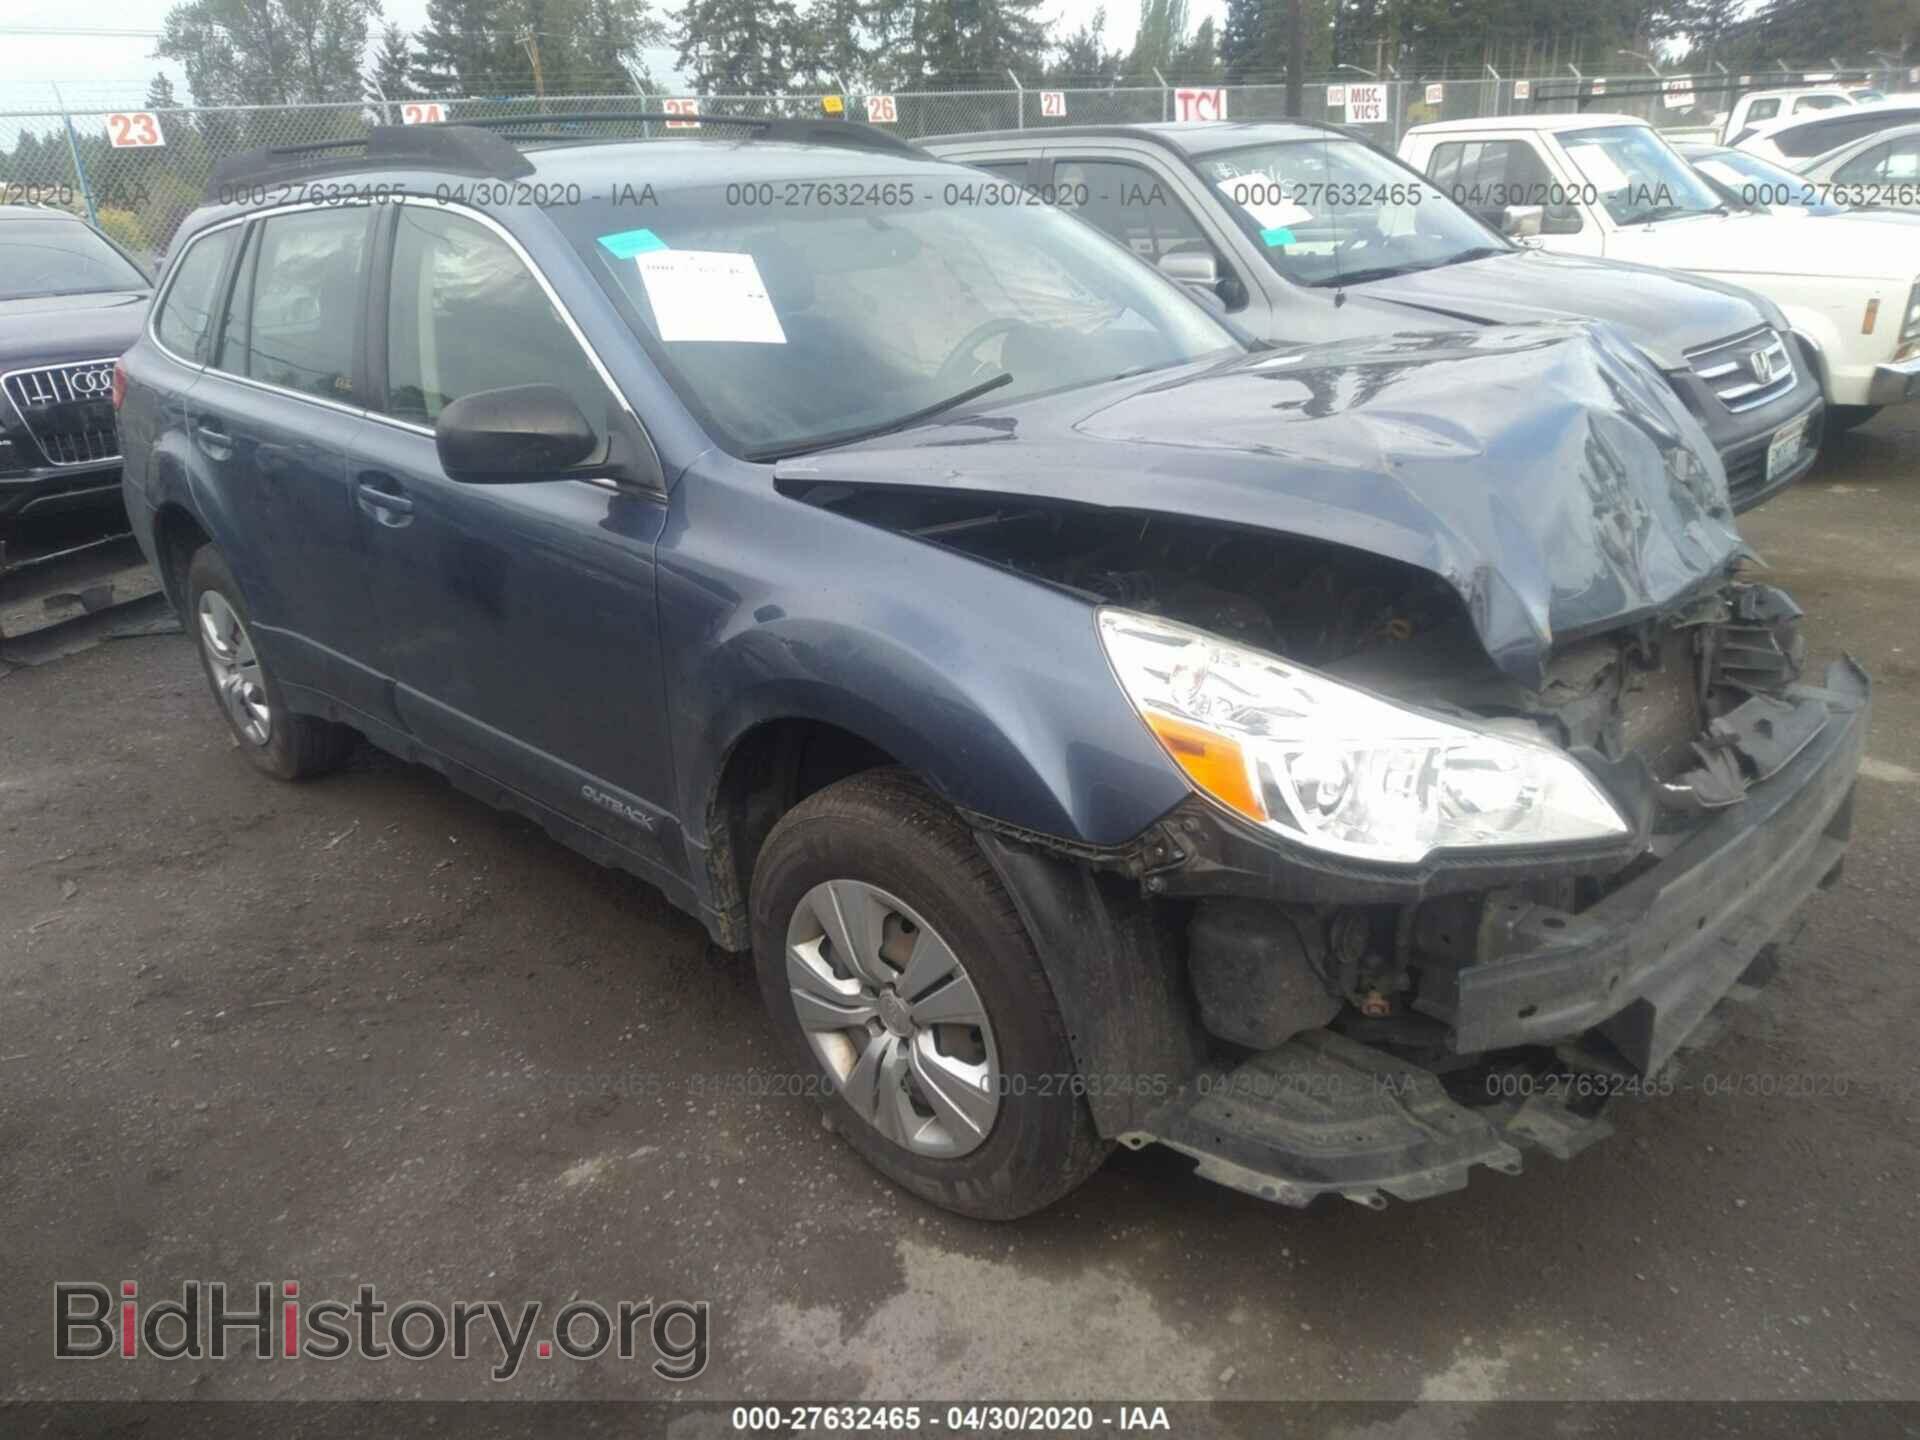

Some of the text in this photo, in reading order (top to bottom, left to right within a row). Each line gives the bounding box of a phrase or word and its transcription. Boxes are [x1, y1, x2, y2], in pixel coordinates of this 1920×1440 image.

[1043, 94, 1061, 114] 27
[1351, 88, 1381, 103] MISC.
[869, 97, 894, 120] 26
[111, 114, 157, 145] 23
[582, 785, 655, 831] OUTBACK
